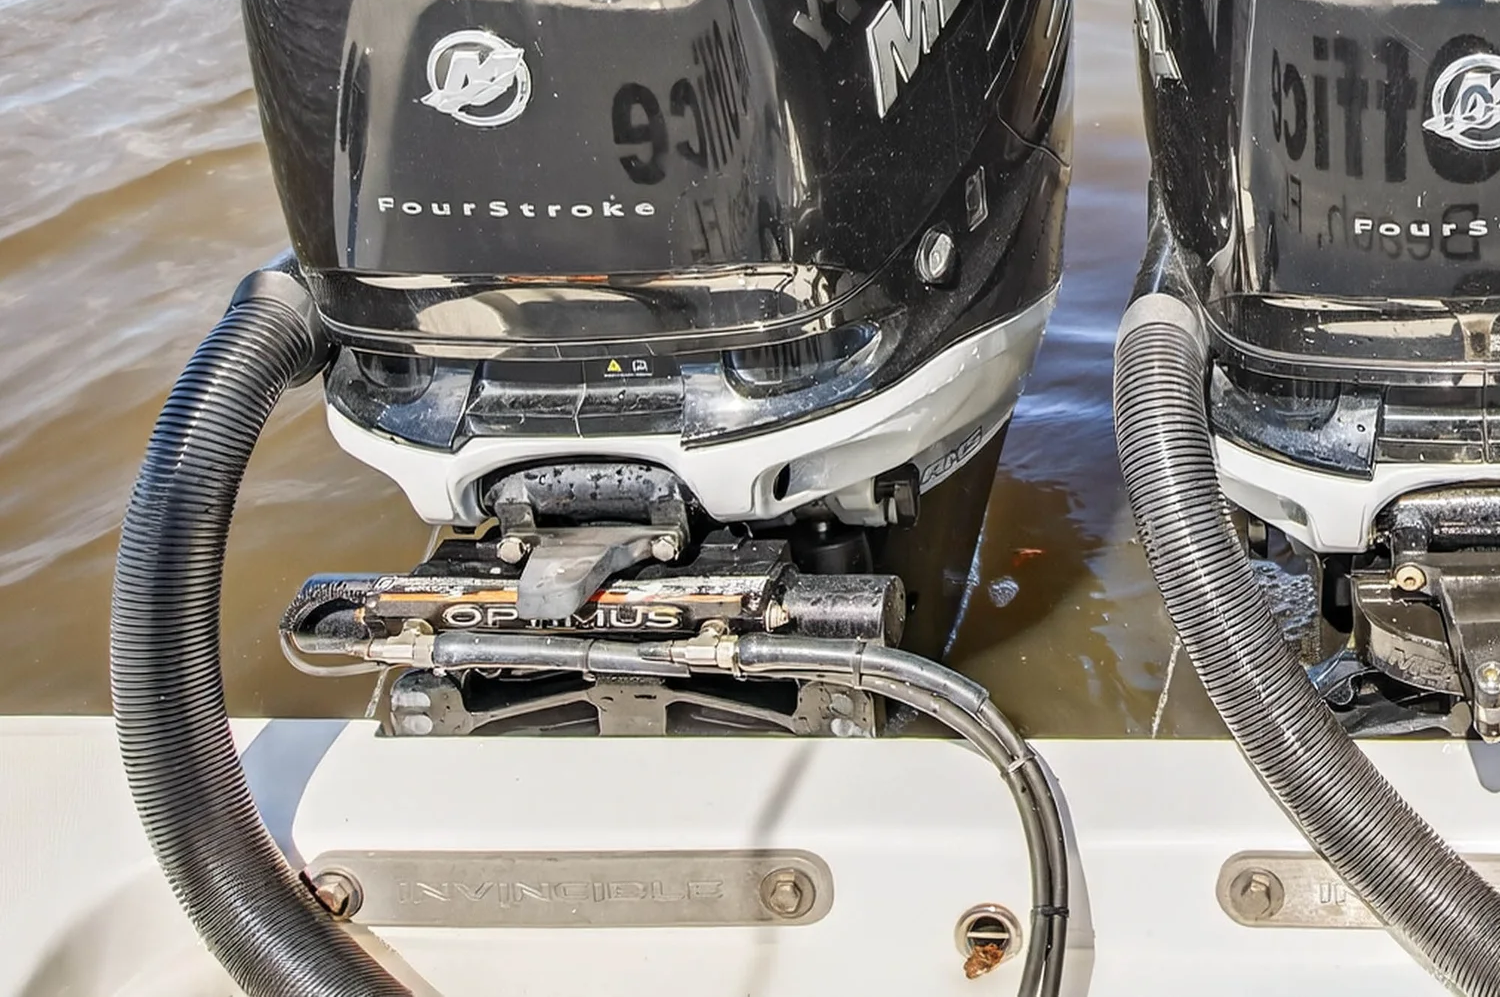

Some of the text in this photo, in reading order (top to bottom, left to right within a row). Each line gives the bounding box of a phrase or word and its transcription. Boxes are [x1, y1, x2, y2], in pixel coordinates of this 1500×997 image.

[377, 195, 656, 219] FourStroke
[442, 603, 682, 629] OPMUS
[396, 880, 725, 907] INVINCIBLE
